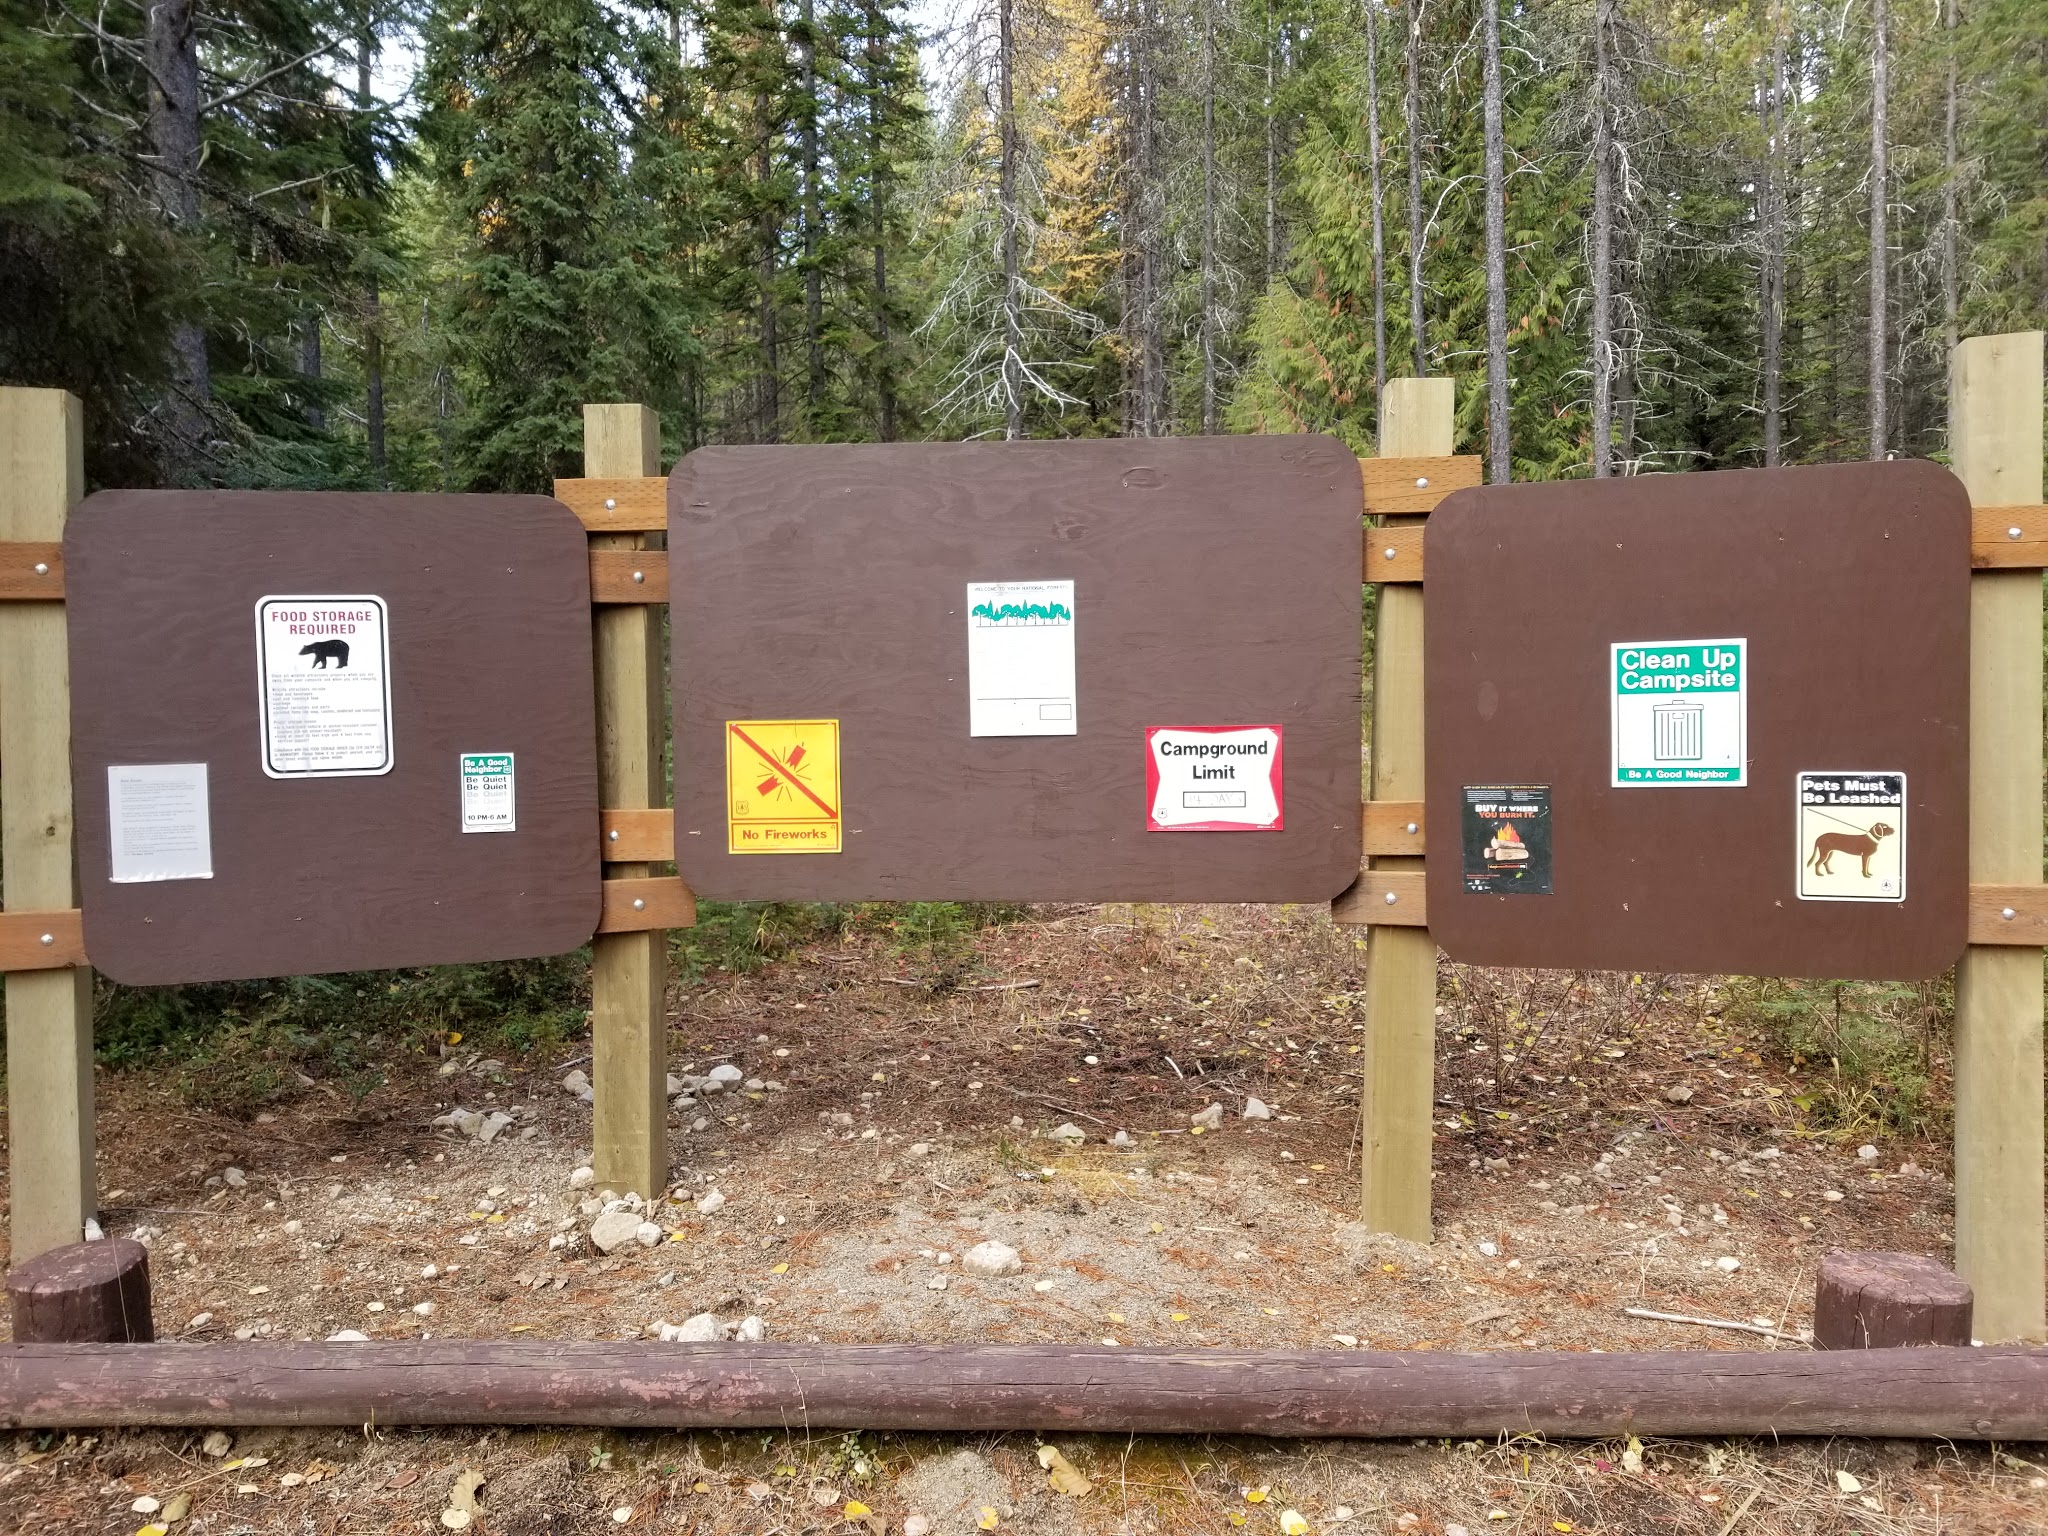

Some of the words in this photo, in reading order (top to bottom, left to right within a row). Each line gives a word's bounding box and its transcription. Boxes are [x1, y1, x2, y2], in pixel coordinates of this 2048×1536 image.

[272, 612, 307, 622] FOOD
[312, 611, 372, 621] STORAGE
[290, 624, 356, 635] REQUIRED
[1621, 650, 1690, 670] Clean
[1702, 648, 1736, 670] Up
[1621, 670, 1736, 691] Campsite
[1160, 741, 1268, 758] Campground
[465, 766, 502, 774] Neighbor
[1192, 765, 1235, 779] Limit
[1628, 770, 1641, 778] Be
[1645, 770, 1652, 778] A
[1656, 770, 1682, 778] Good
[1686, 770, 1729, 780] Neighbor
[1802, 780, 1840, 791] Pets
[1844, 780, 1886, 791] Must
[1802, 793, 1825, 803] Be
[1829, 793, 1901, 804] Leashed
[742, 830, 759, 840] No
[765, 829, 827, 839] Fireworks
